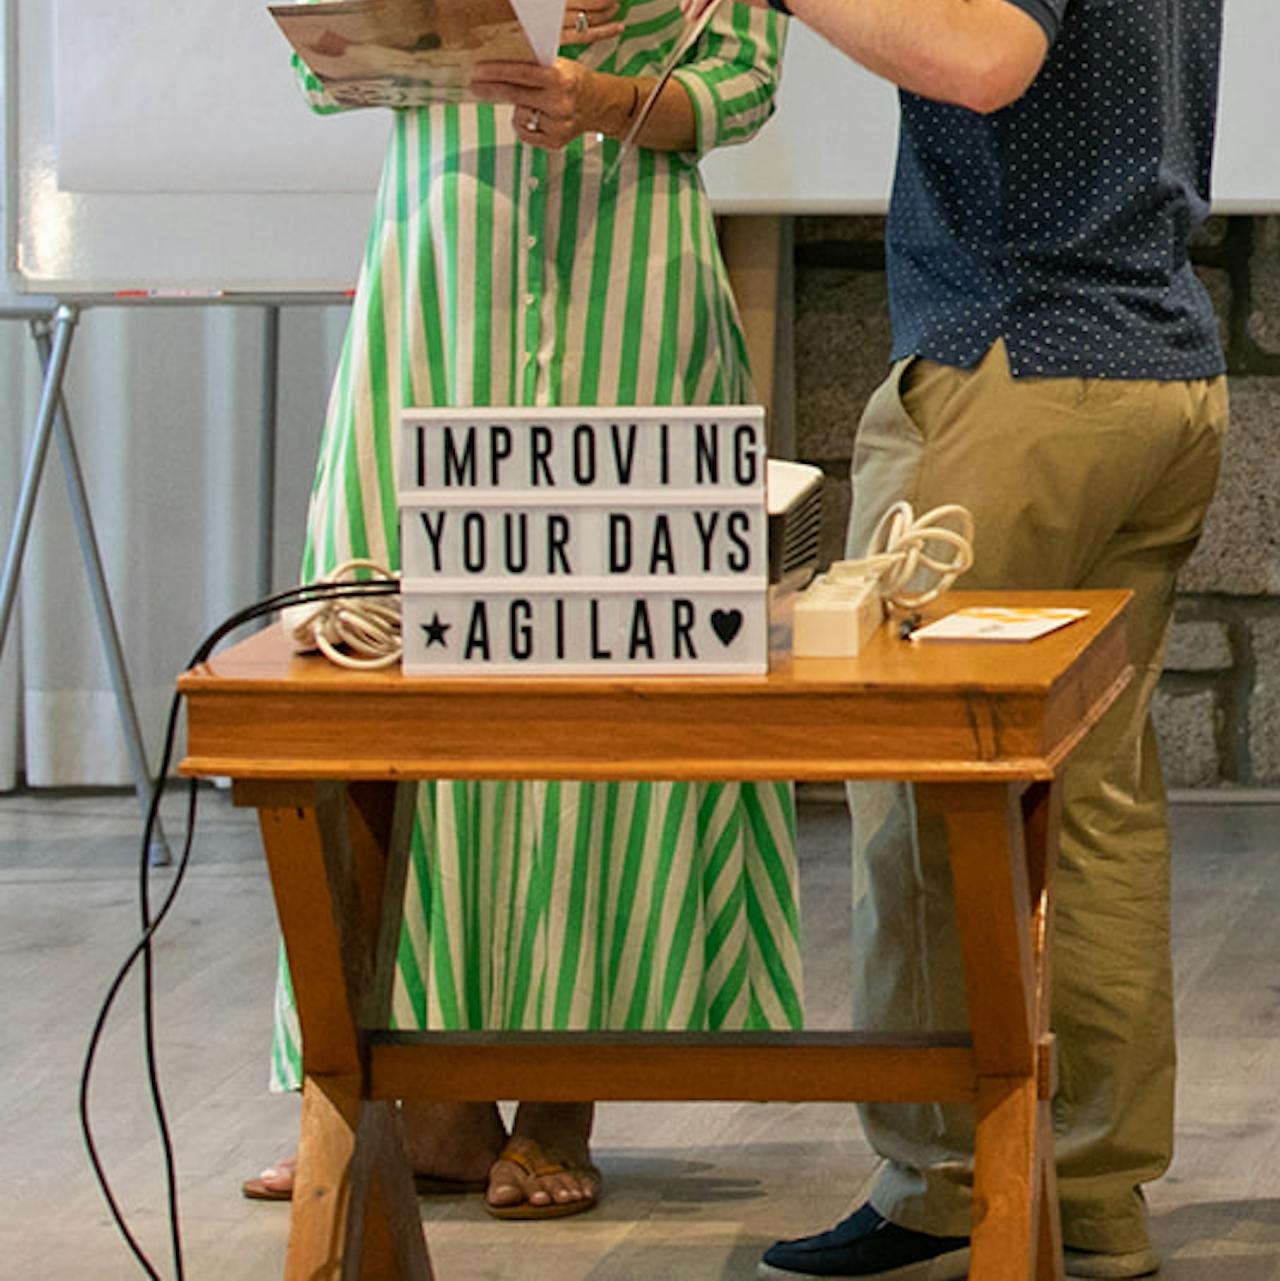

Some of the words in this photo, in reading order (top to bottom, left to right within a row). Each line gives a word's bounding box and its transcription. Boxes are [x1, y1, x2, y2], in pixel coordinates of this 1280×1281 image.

[415, 423, 757, 488] IMPROVING
[420, 510, 572, 575] YOUR
[607, 510, 752, 574] DAYS
[463, 598, 699, 660] AGILAR
